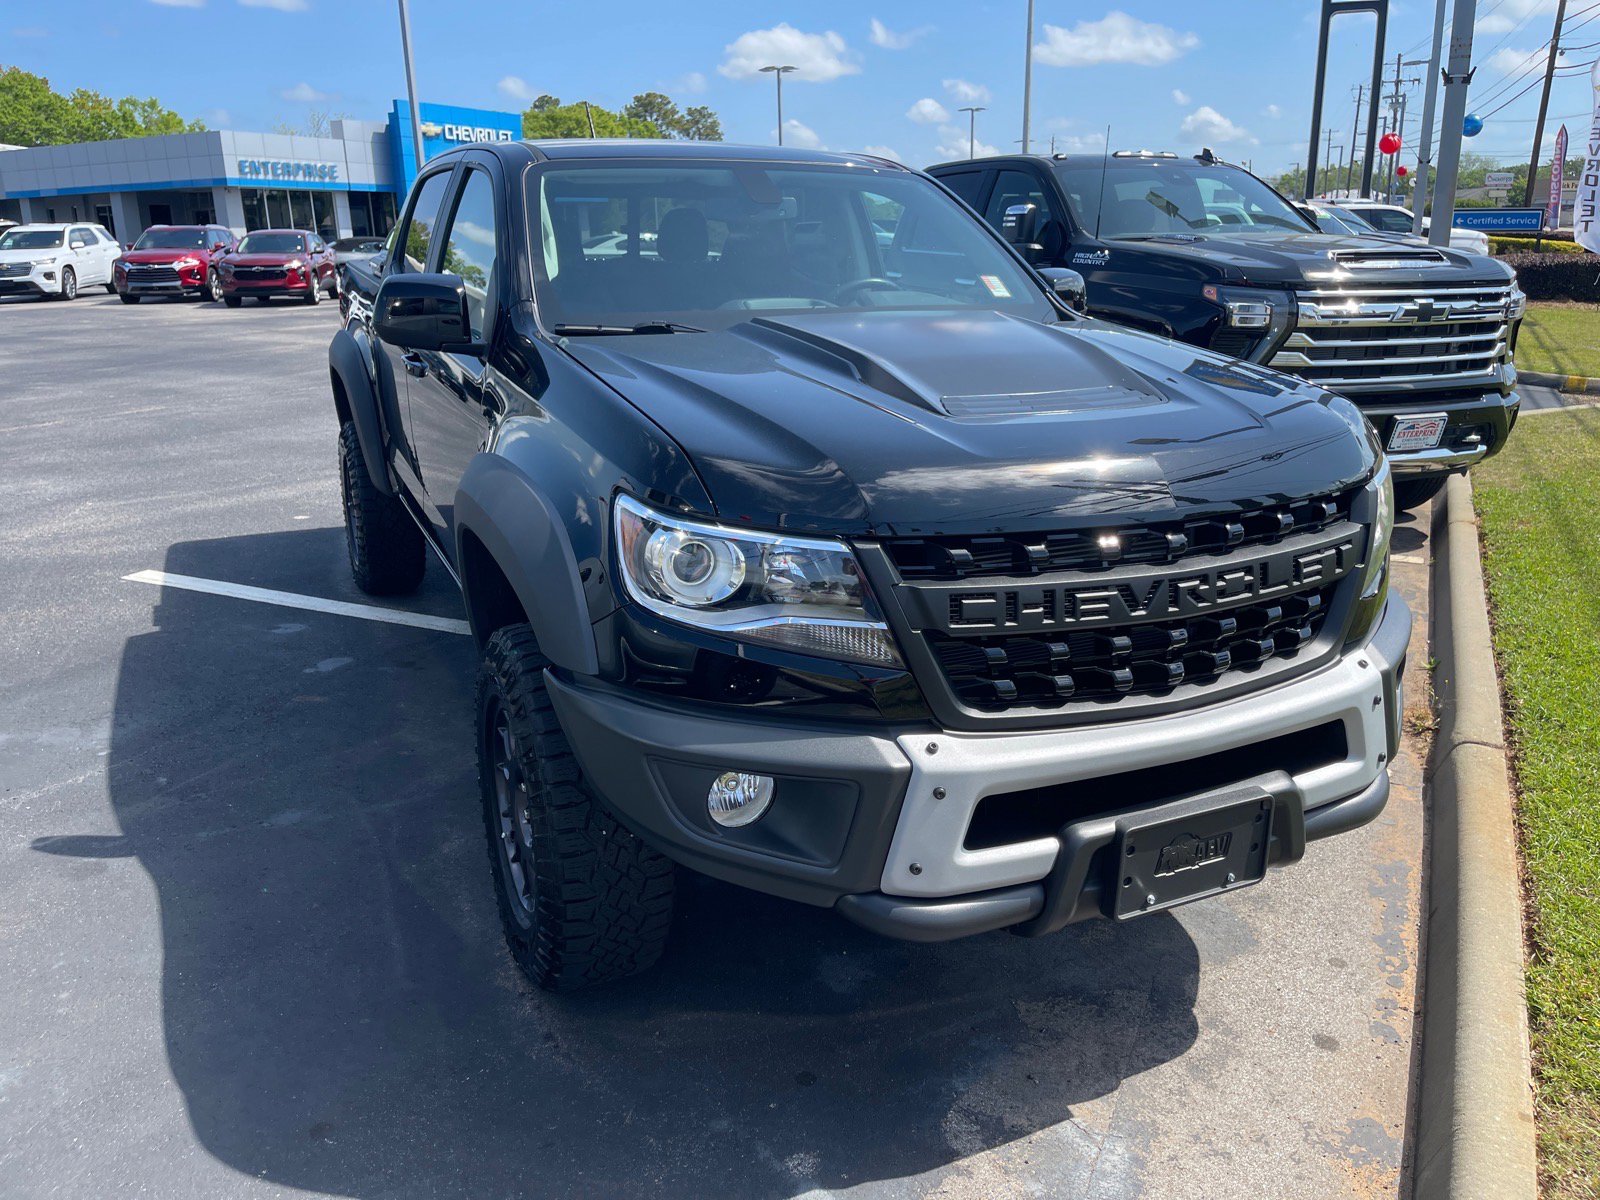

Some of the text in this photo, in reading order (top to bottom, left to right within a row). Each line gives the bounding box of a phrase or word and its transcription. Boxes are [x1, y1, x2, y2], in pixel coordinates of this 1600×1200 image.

[444, 124, 513, 142] CHEVROLET
[238, 159, 340, 180] ENTERPRISE
[1466, 217, 1537, 225] Certified Service
[1072, 258, 1106, 266] COUNTRY
[1397, 429, 1438, 438] ENTERPRISE
[948, 544, 1354, 628] CHEVROLET
[1195, 834, 1229, 863] AEV
